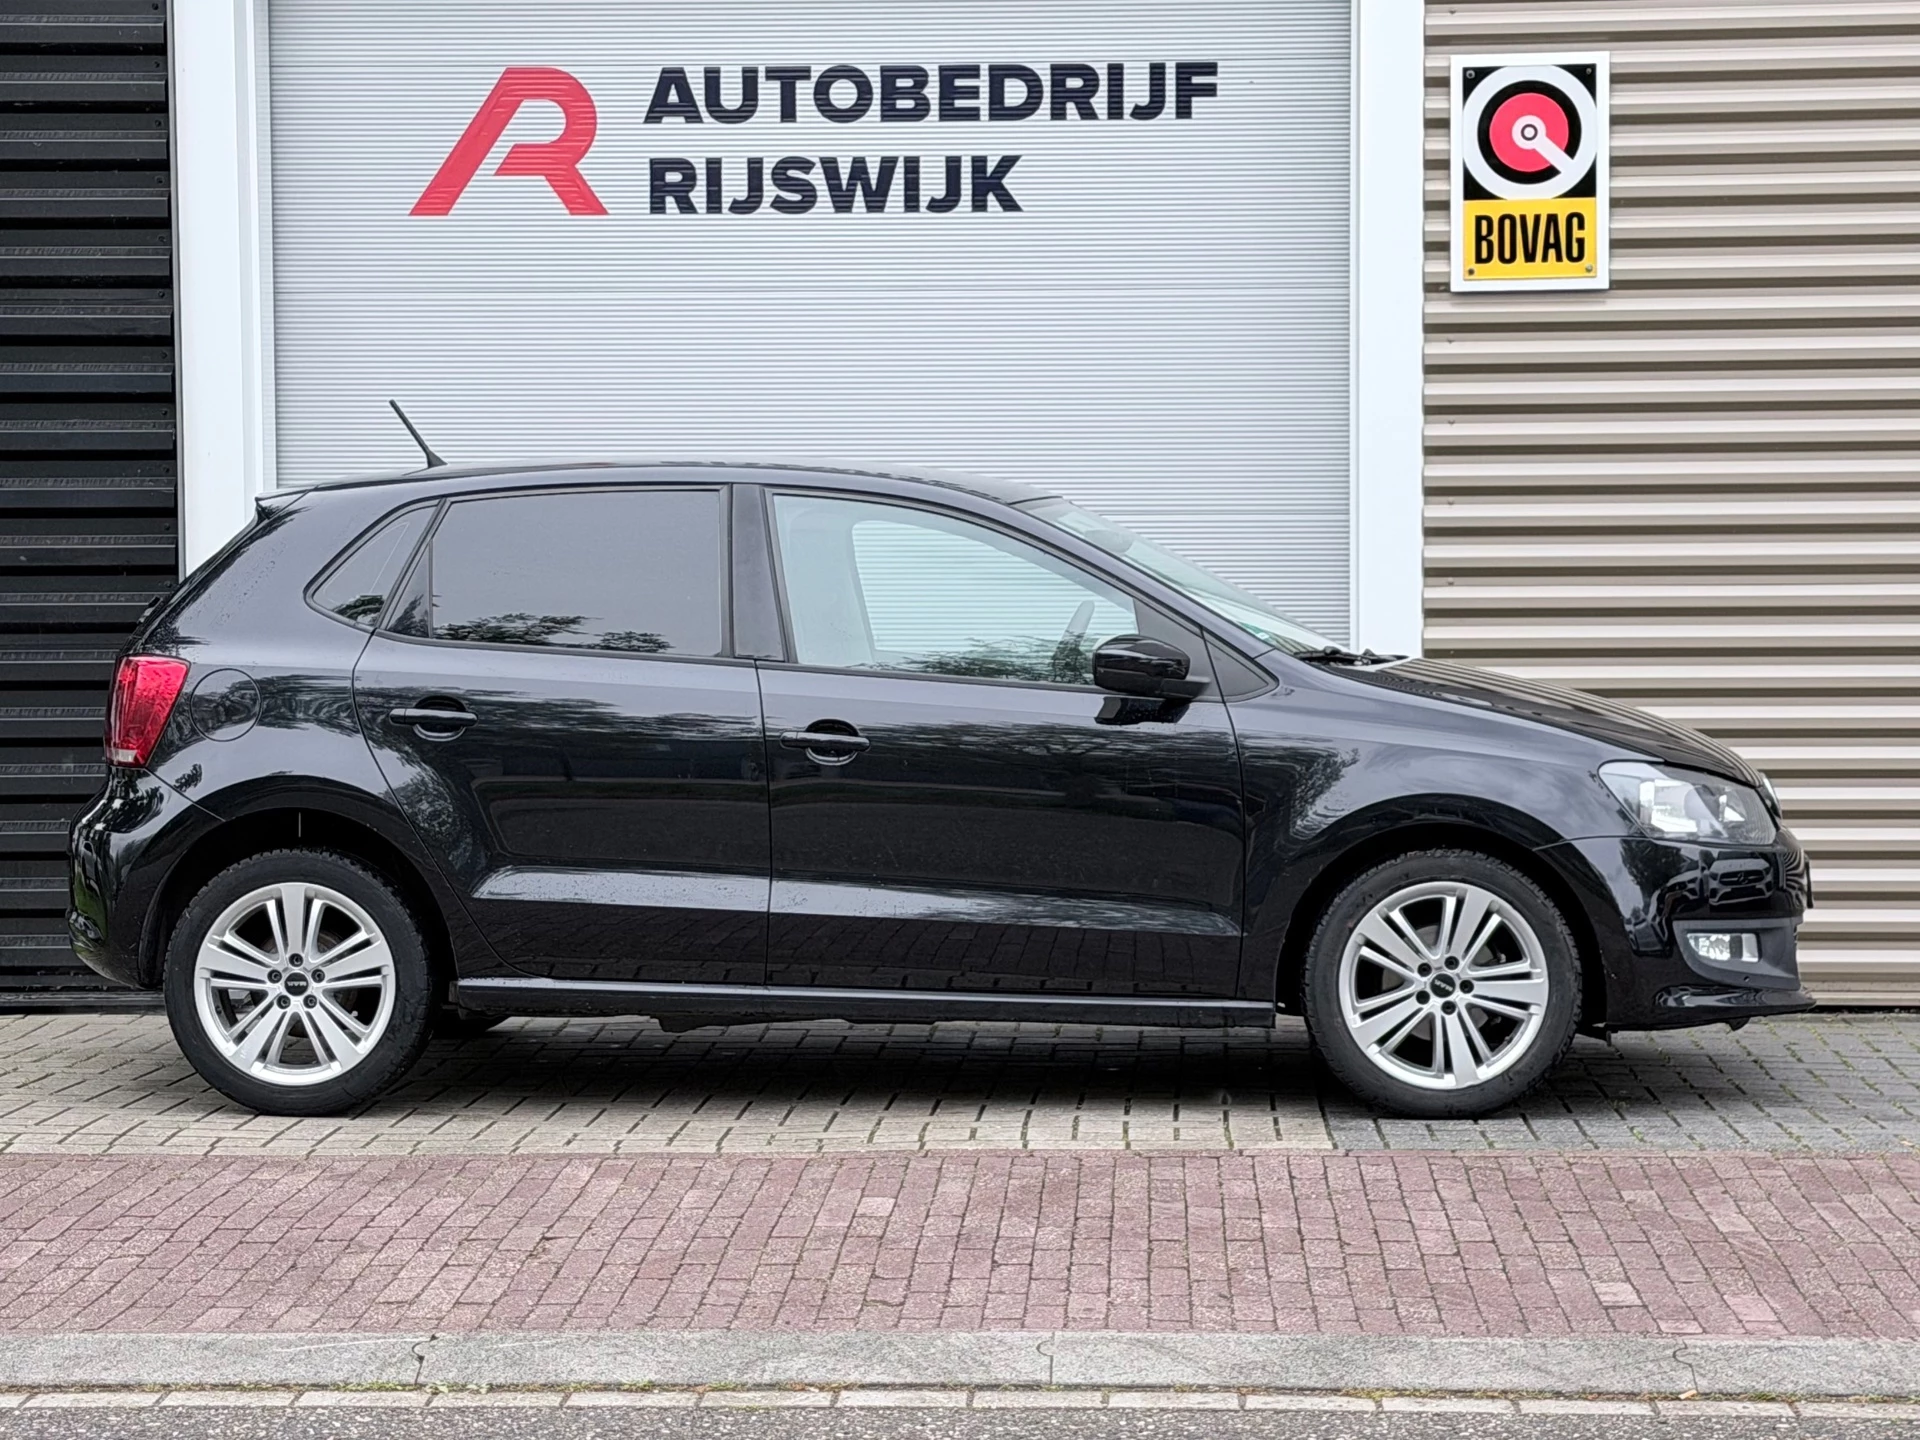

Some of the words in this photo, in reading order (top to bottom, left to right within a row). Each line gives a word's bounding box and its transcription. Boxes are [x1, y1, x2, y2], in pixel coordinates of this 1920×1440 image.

[643, 62, 1218, 124] AUTOBEDRIJF
[649, 155, 1023, 214] RIJSWIJK
[1474, 212, 1586, 264] BOVAG
